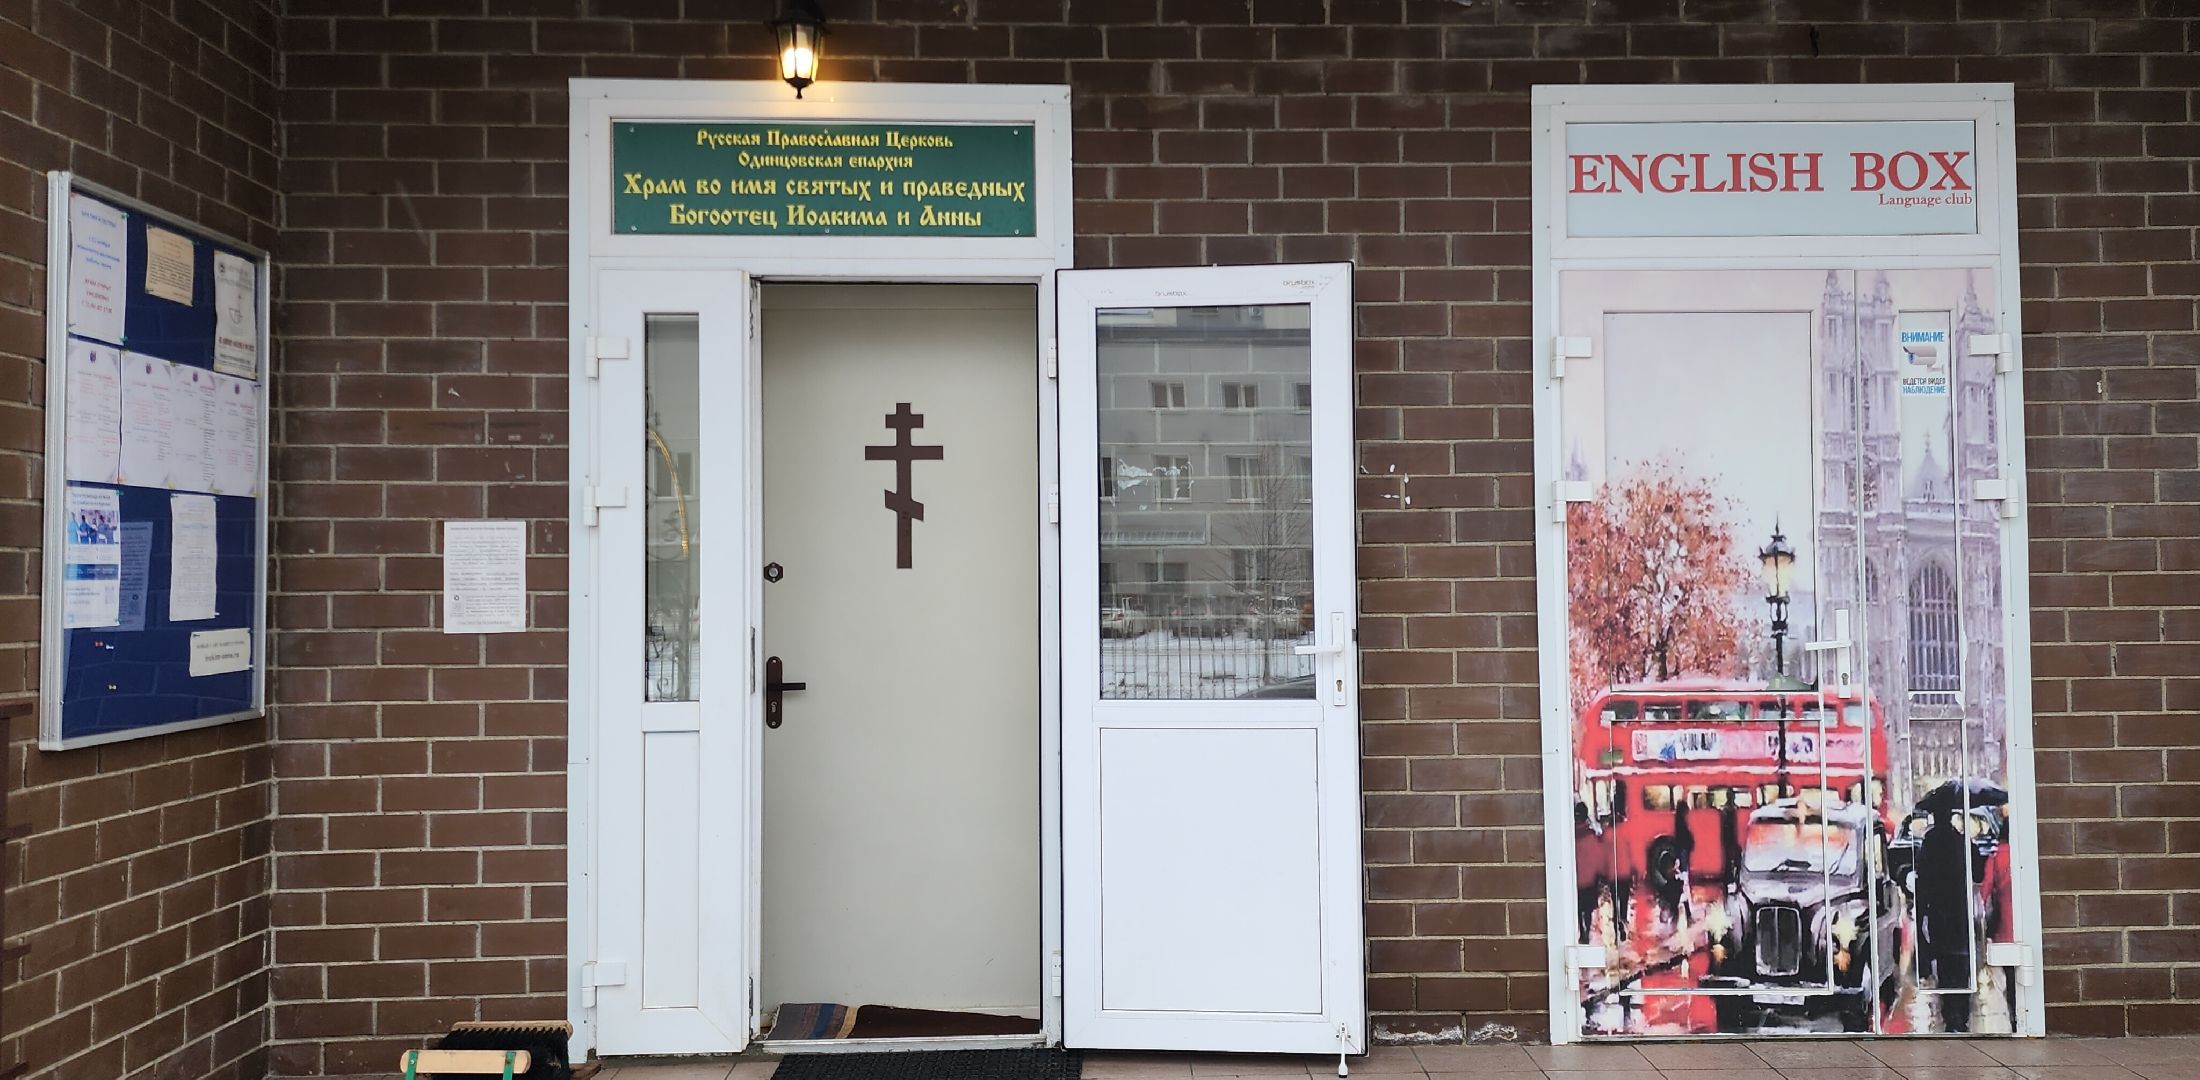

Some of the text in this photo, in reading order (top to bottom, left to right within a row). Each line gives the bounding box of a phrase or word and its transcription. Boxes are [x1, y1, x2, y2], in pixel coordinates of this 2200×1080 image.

[697, 128, 954, 149] Русская Православная Церковь
[738, 151, 913, 172] Одинцовская епархия
[1569, 151, 1972, 194] ENGLISH BOX
[623, 173, 1026, 202] Храм во имя святых и праведных
[1879, 192, 1973, 209] Language club
[669, 204, 982, 228] Богоотец Иоакима и Анны
[1901, 331, 1945, 343] ВНИМАНИЕ
[1903, 377, 1946, 385] ВЕДЕТСЯ ВИДЕО
[1903, 386, 1946, 394] НАБЛЮДЕНИЕ
